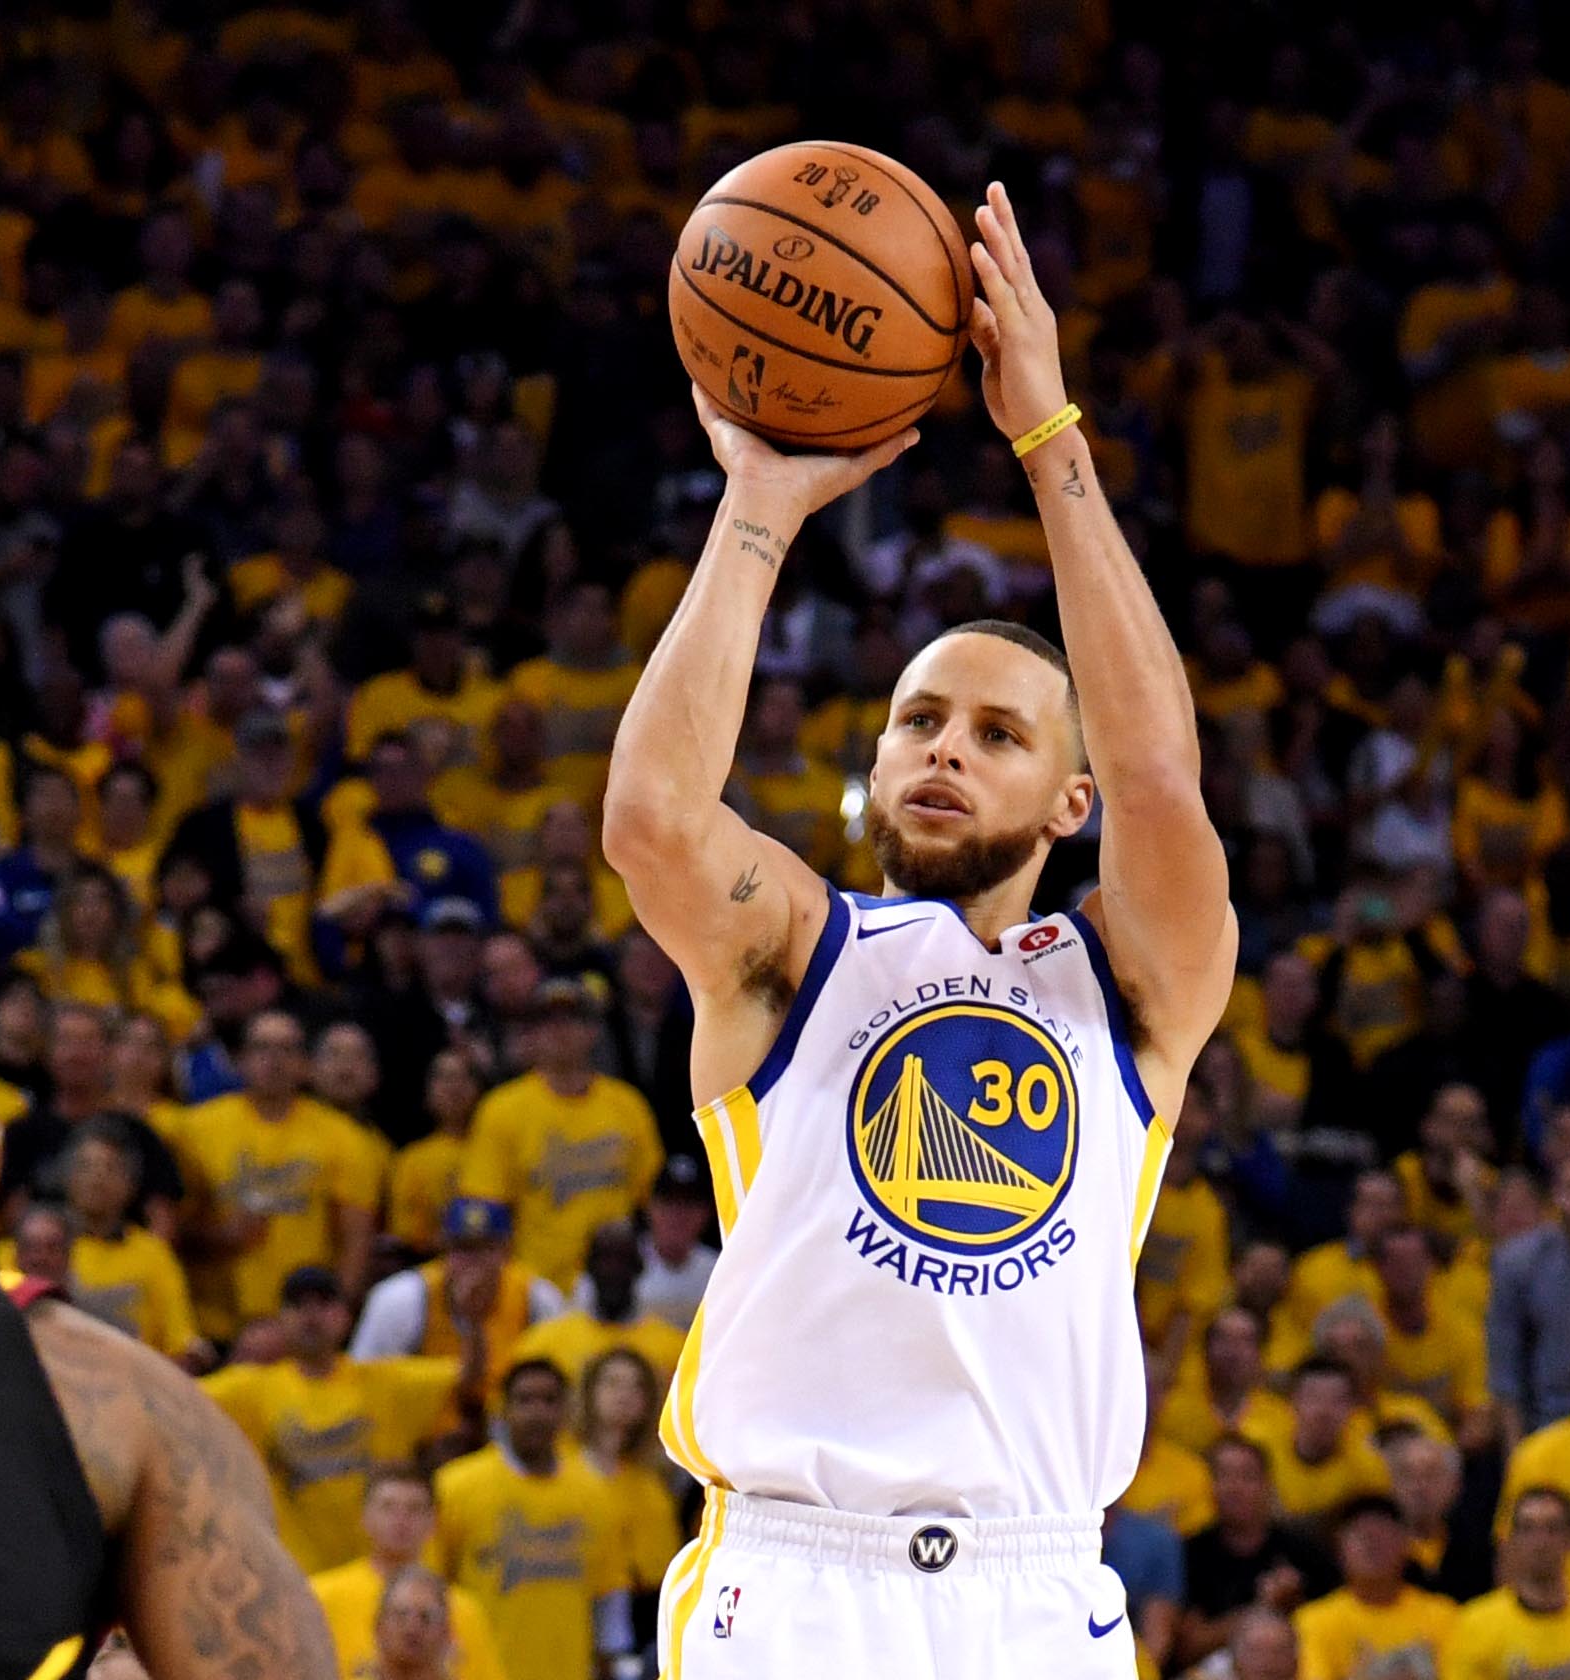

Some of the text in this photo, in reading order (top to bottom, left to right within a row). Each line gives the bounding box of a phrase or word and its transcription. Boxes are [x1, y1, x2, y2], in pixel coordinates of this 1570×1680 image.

[793, 162, 881, 216] 20 18
[691, 224, 883, 355] SPALDING
[1022, 938, 1078, 965] Rakuten
[848, 974, 992, 1051] GOLDEN
[967, 1059, 1061, 1132] 30
[844, 1206, 1077, 1297] WARRIORS
[915, 1535, 953, 1563] W
